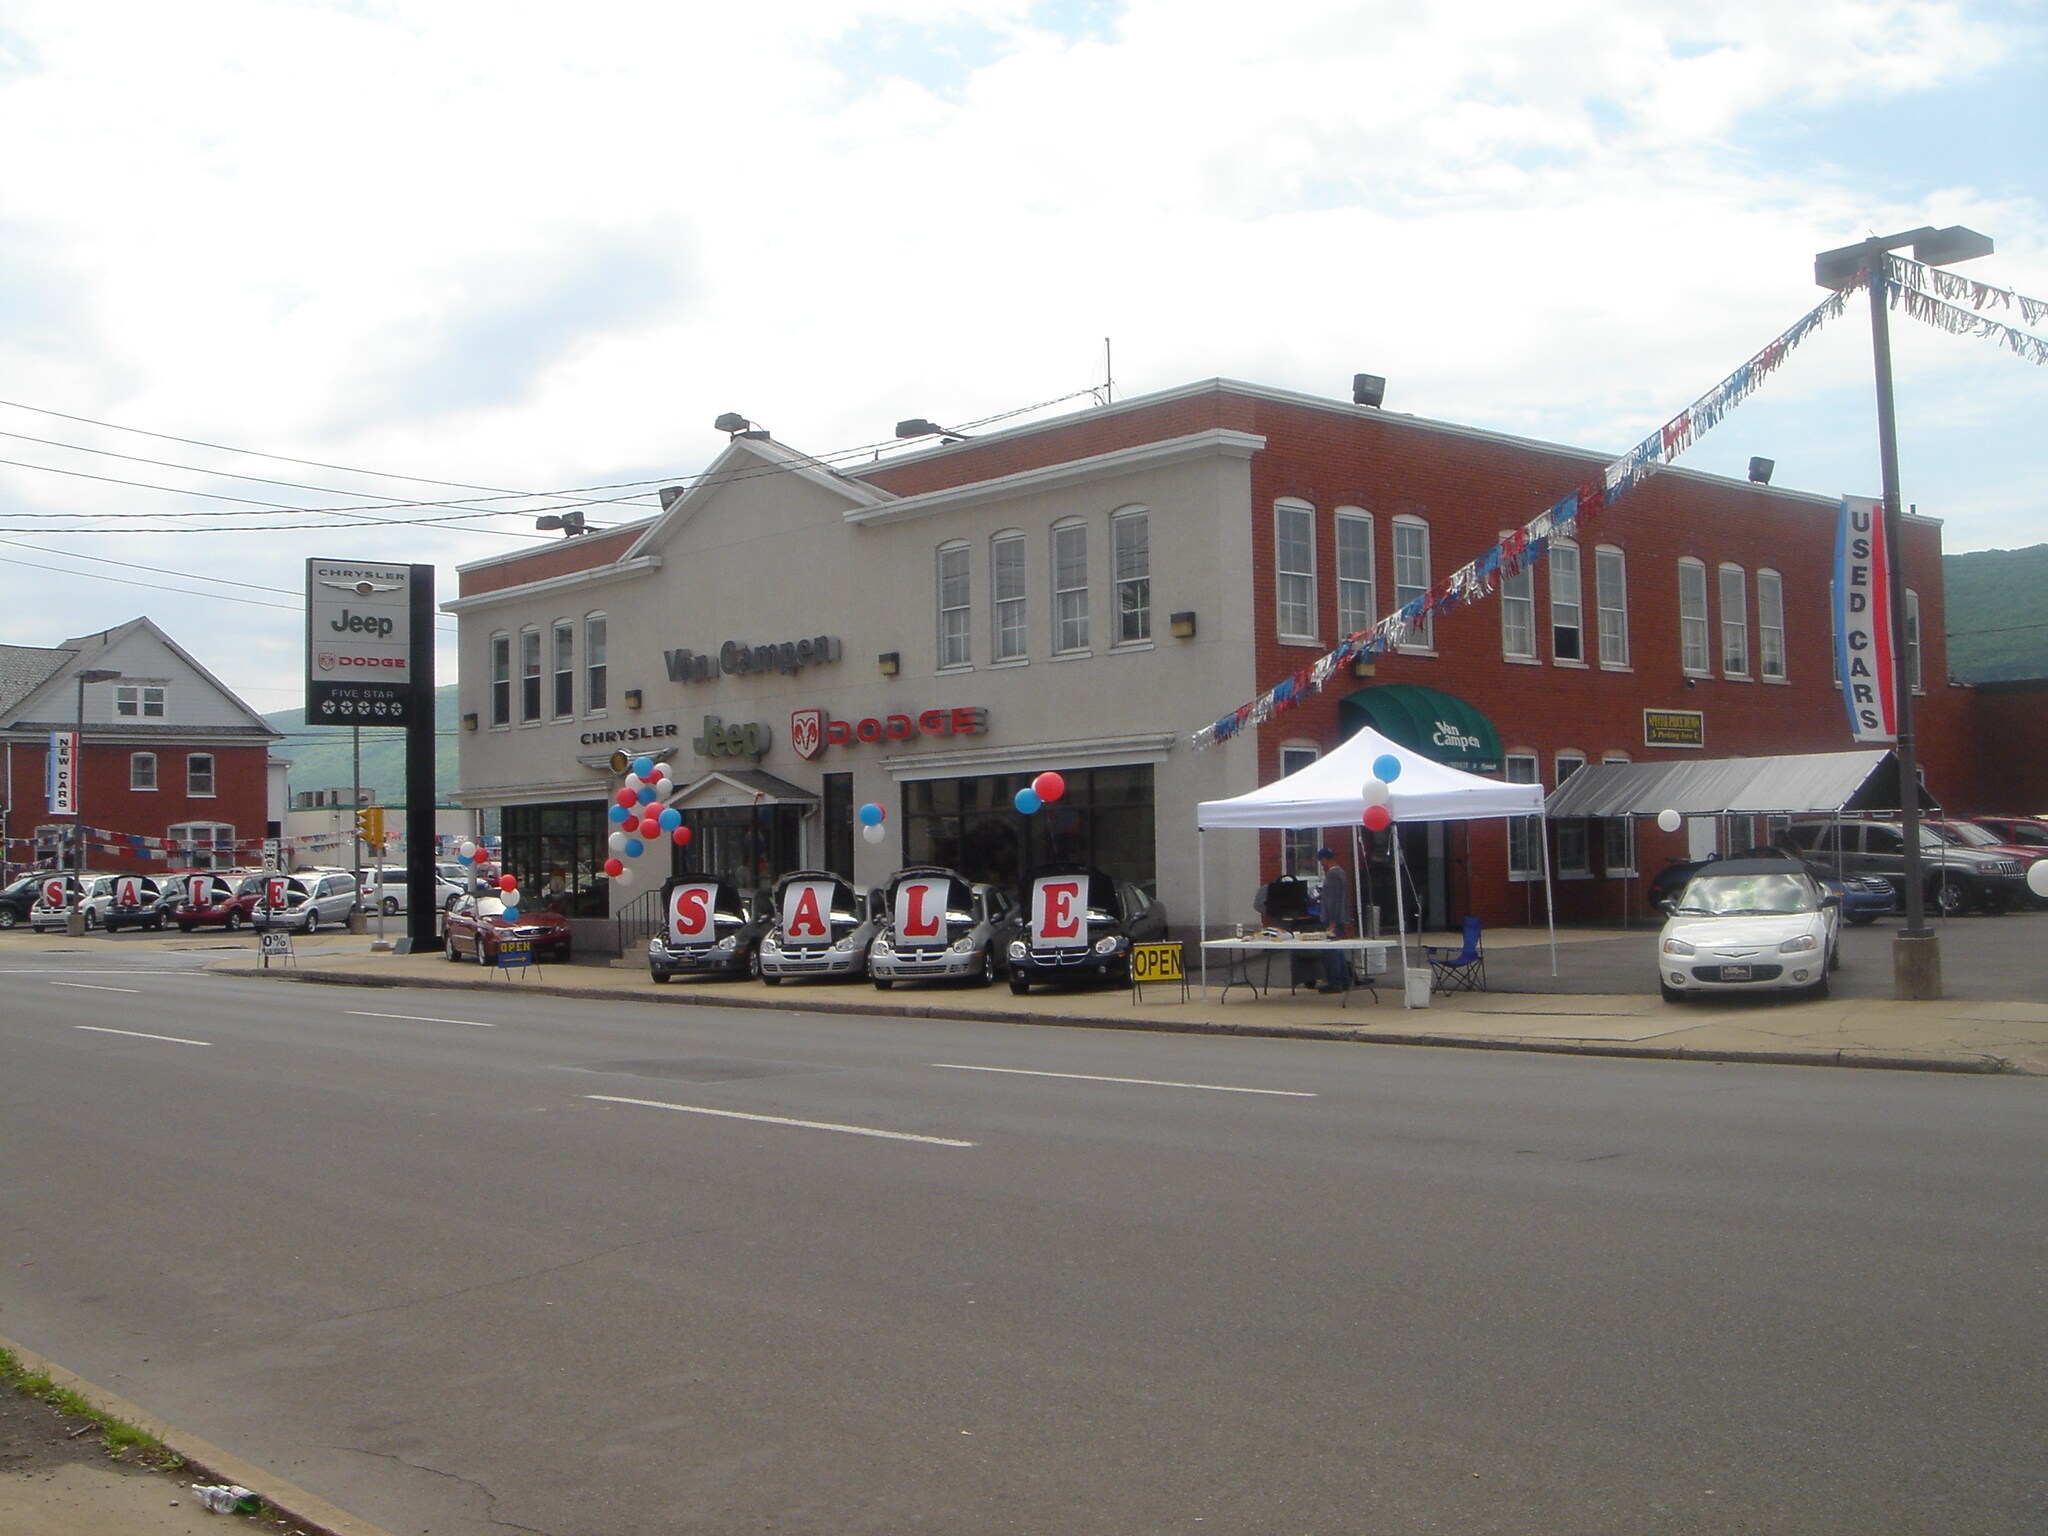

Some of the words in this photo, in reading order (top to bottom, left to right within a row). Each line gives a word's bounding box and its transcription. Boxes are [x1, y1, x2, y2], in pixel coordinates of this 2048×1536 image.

[318, 568, 405, 581] CHRYSLER
[1850, 511, 1870, 613] USED
[331, 609, 393, 638] Jeep
[338, 656, 406, 669] DODGE
[664, 649, 715, 683] Van
[720, 636, 837, 677] Campen
[1848, 630, 1878, 729] CARS
[332, 689, 359, 698] FIVE
[363, 689, 394, 698] STAR
[580, 723, 678, 746] CHRYSLER
[693, 715, 768, 762] Jeep
[828, 706, 987, 746] DODGE
[1434, 721, 1460, 736] Van
[59, 738, 69, 765] NEW
[1432, 732, 1481, 752] Campen
[58, 771, 69, 808] CARS
[264, 935, 286, 947] 0%
[500, 941, 531, 953] OPEN
[1135, 949, 1184, 977] OPEN
